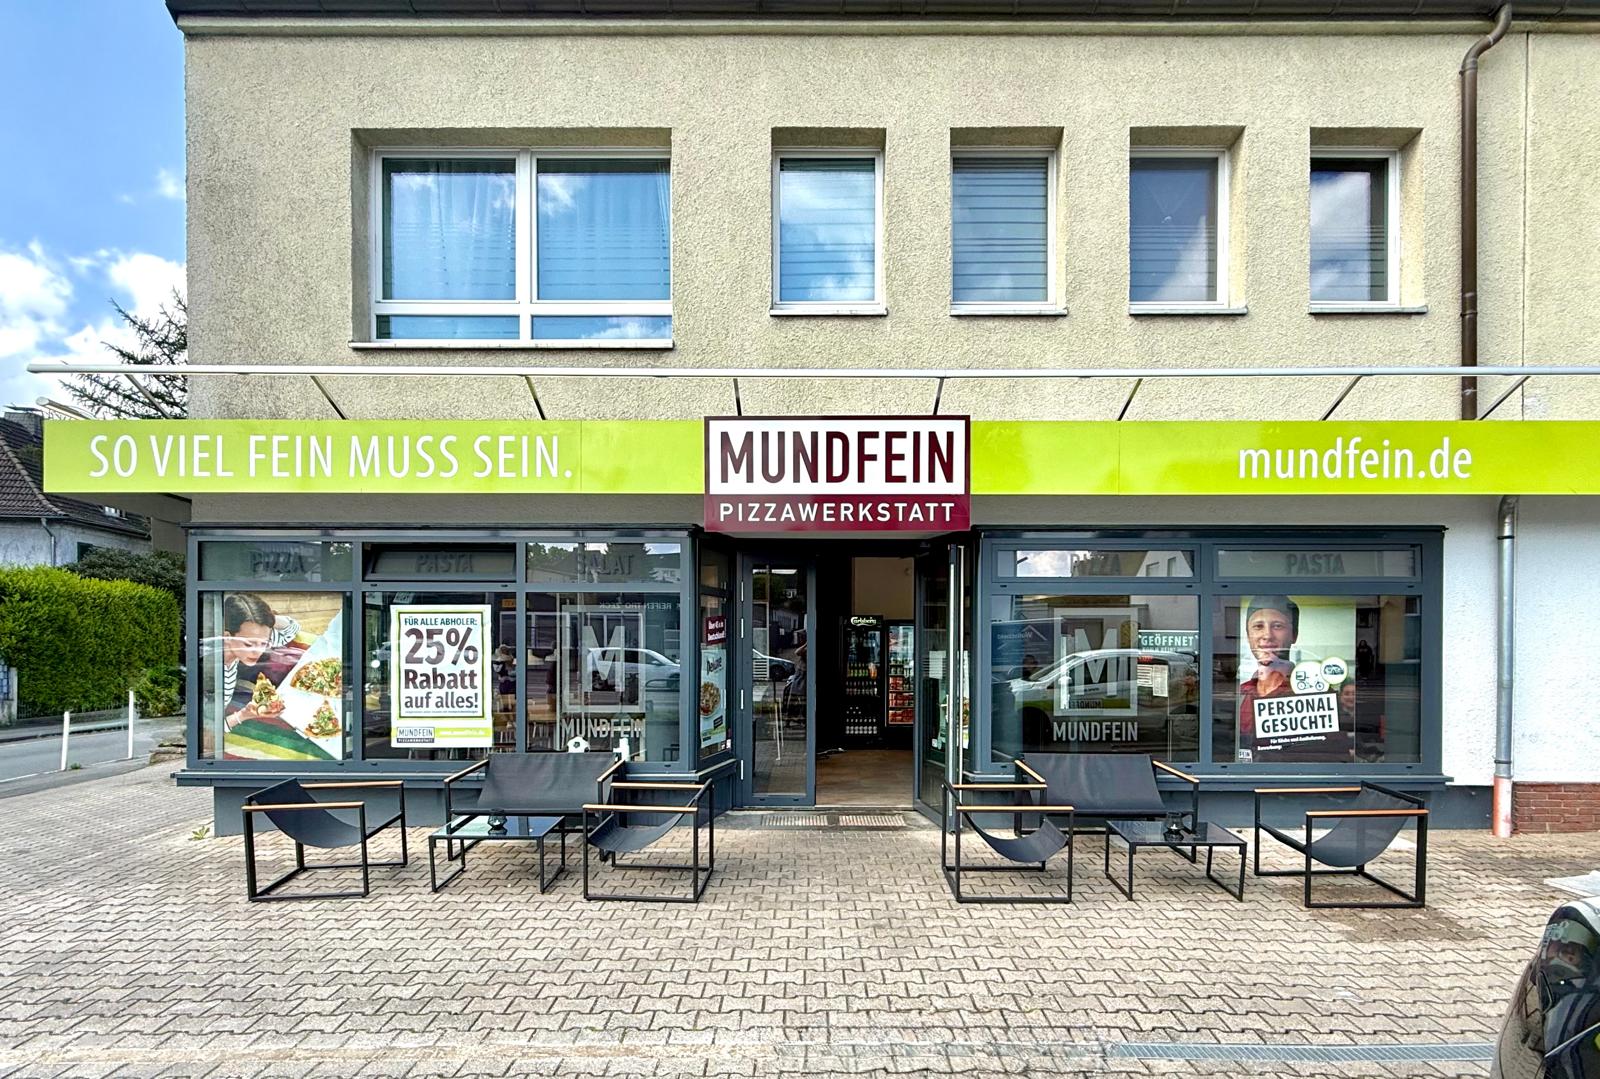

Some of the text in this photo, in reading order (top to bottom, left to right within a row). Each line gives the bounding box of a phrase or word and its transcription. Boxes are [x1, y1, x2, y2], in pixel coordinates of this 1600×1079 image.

[88, 434, 573, 480] SO VIEL FEIN MUSS SEIN.
[720, 430, 954, 484] MUNDFEIN
[1238, 436, 1473, 480] mundfein.de
[719, 502, 955, 523] PIZZAWERKSTATT
[416, 554, 473, 574] PASTA
[1286, 553, 1345, 575] PASTA
[405, 616, 477, 626] FÜR ALLE ABHOLER:
[404, 627, 479, 666] 25%
[1141, 633, 1194, 646] GEÖFFNET
[581, 625, 625, 693] M
[1074, 628, 1118, 696] M
[404, 667, 478, 690] Rabatt
[404, 691, 479, 709] auf alles!
[1257, 696, 1335, 717] PERSONAL
[398, 728, 433, 737] MUNDFEIN
[561, 718, 646, 738] MUNDFEIN
[1053, 721, 1138, 742] MUNDFEIN
[1261, 714, 1333, 735] GESUCHT!
